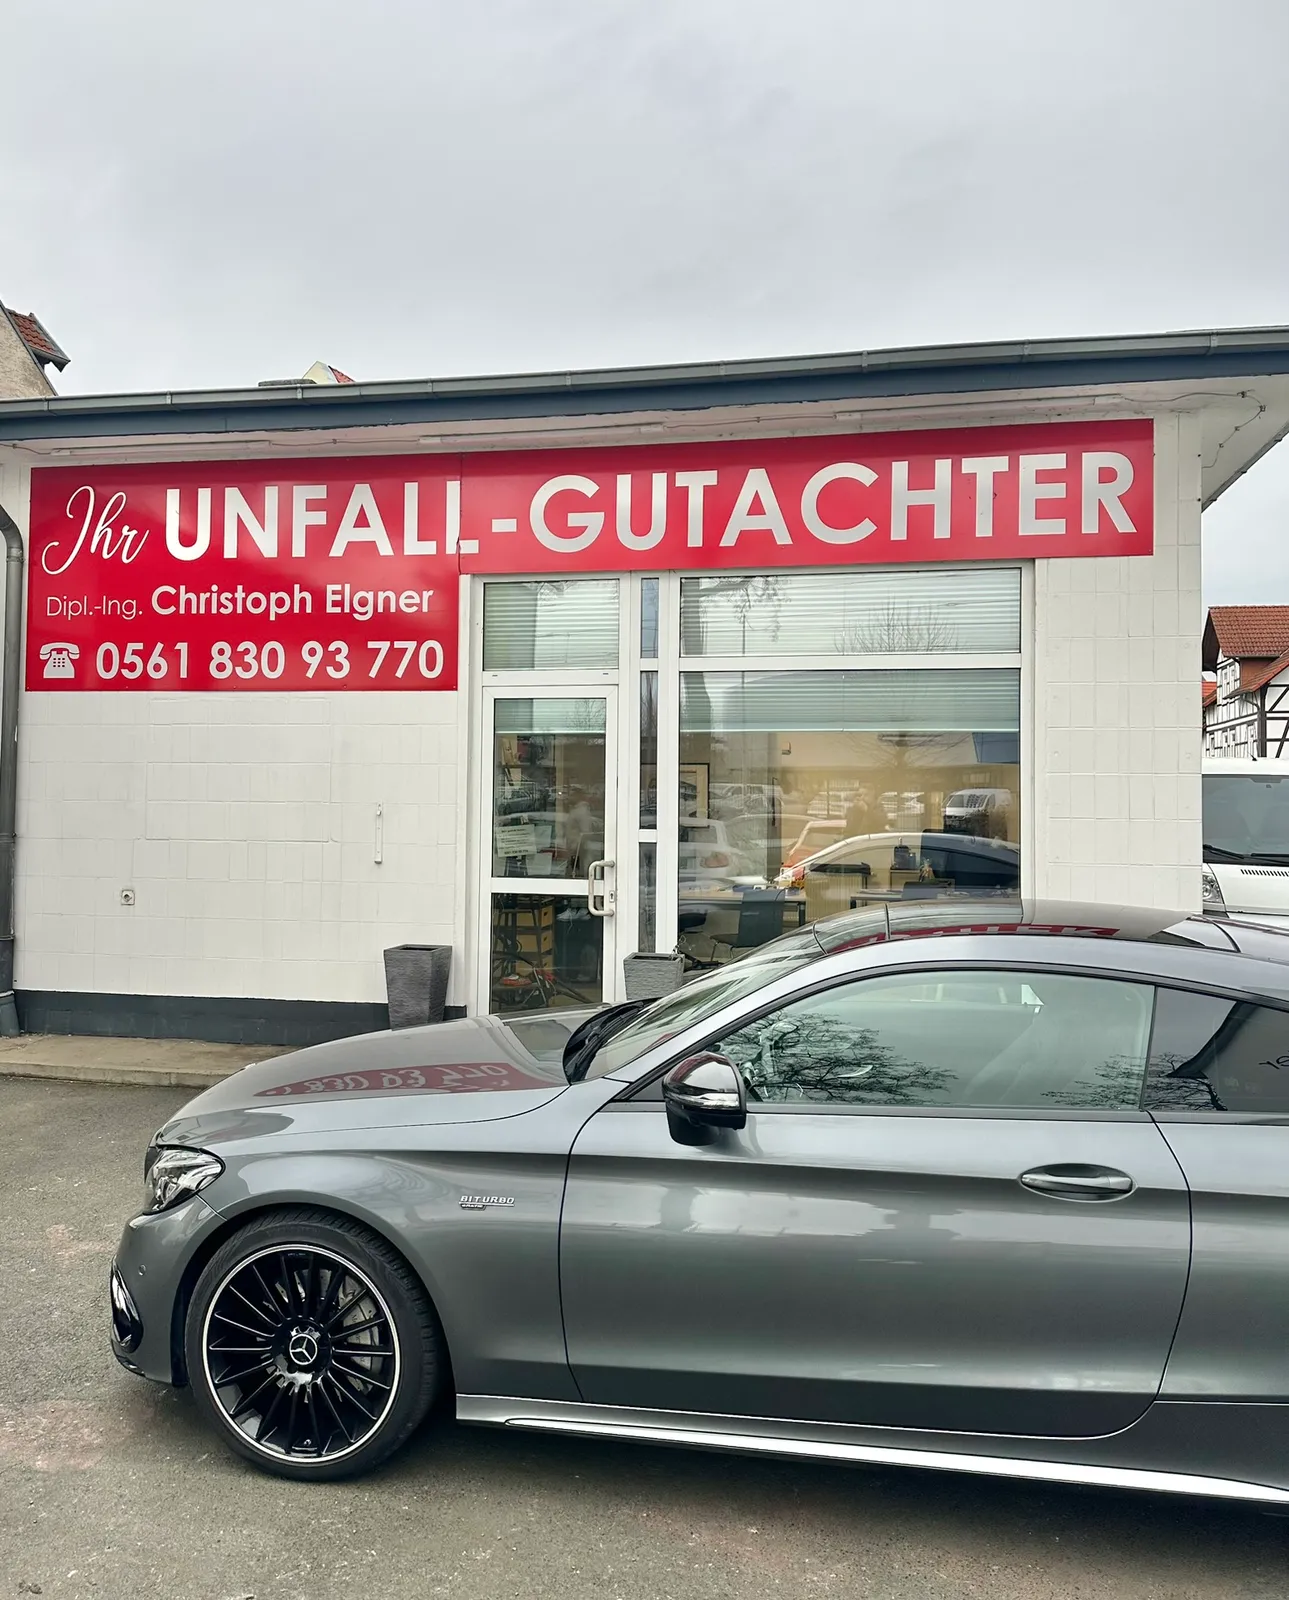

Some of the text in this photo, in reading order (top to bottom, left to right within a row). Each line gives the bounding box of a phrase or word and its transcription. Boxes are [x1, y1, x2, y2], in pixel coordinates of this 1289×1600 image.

[41, 485, 150, 575] Ihr
[46, 583, 435, 621] Dipl.-Ing. Christoph Elgner
[96, 640, 444, 679] 0561 830 93 770
[460, 1195, 515, 1204] BITURBO
